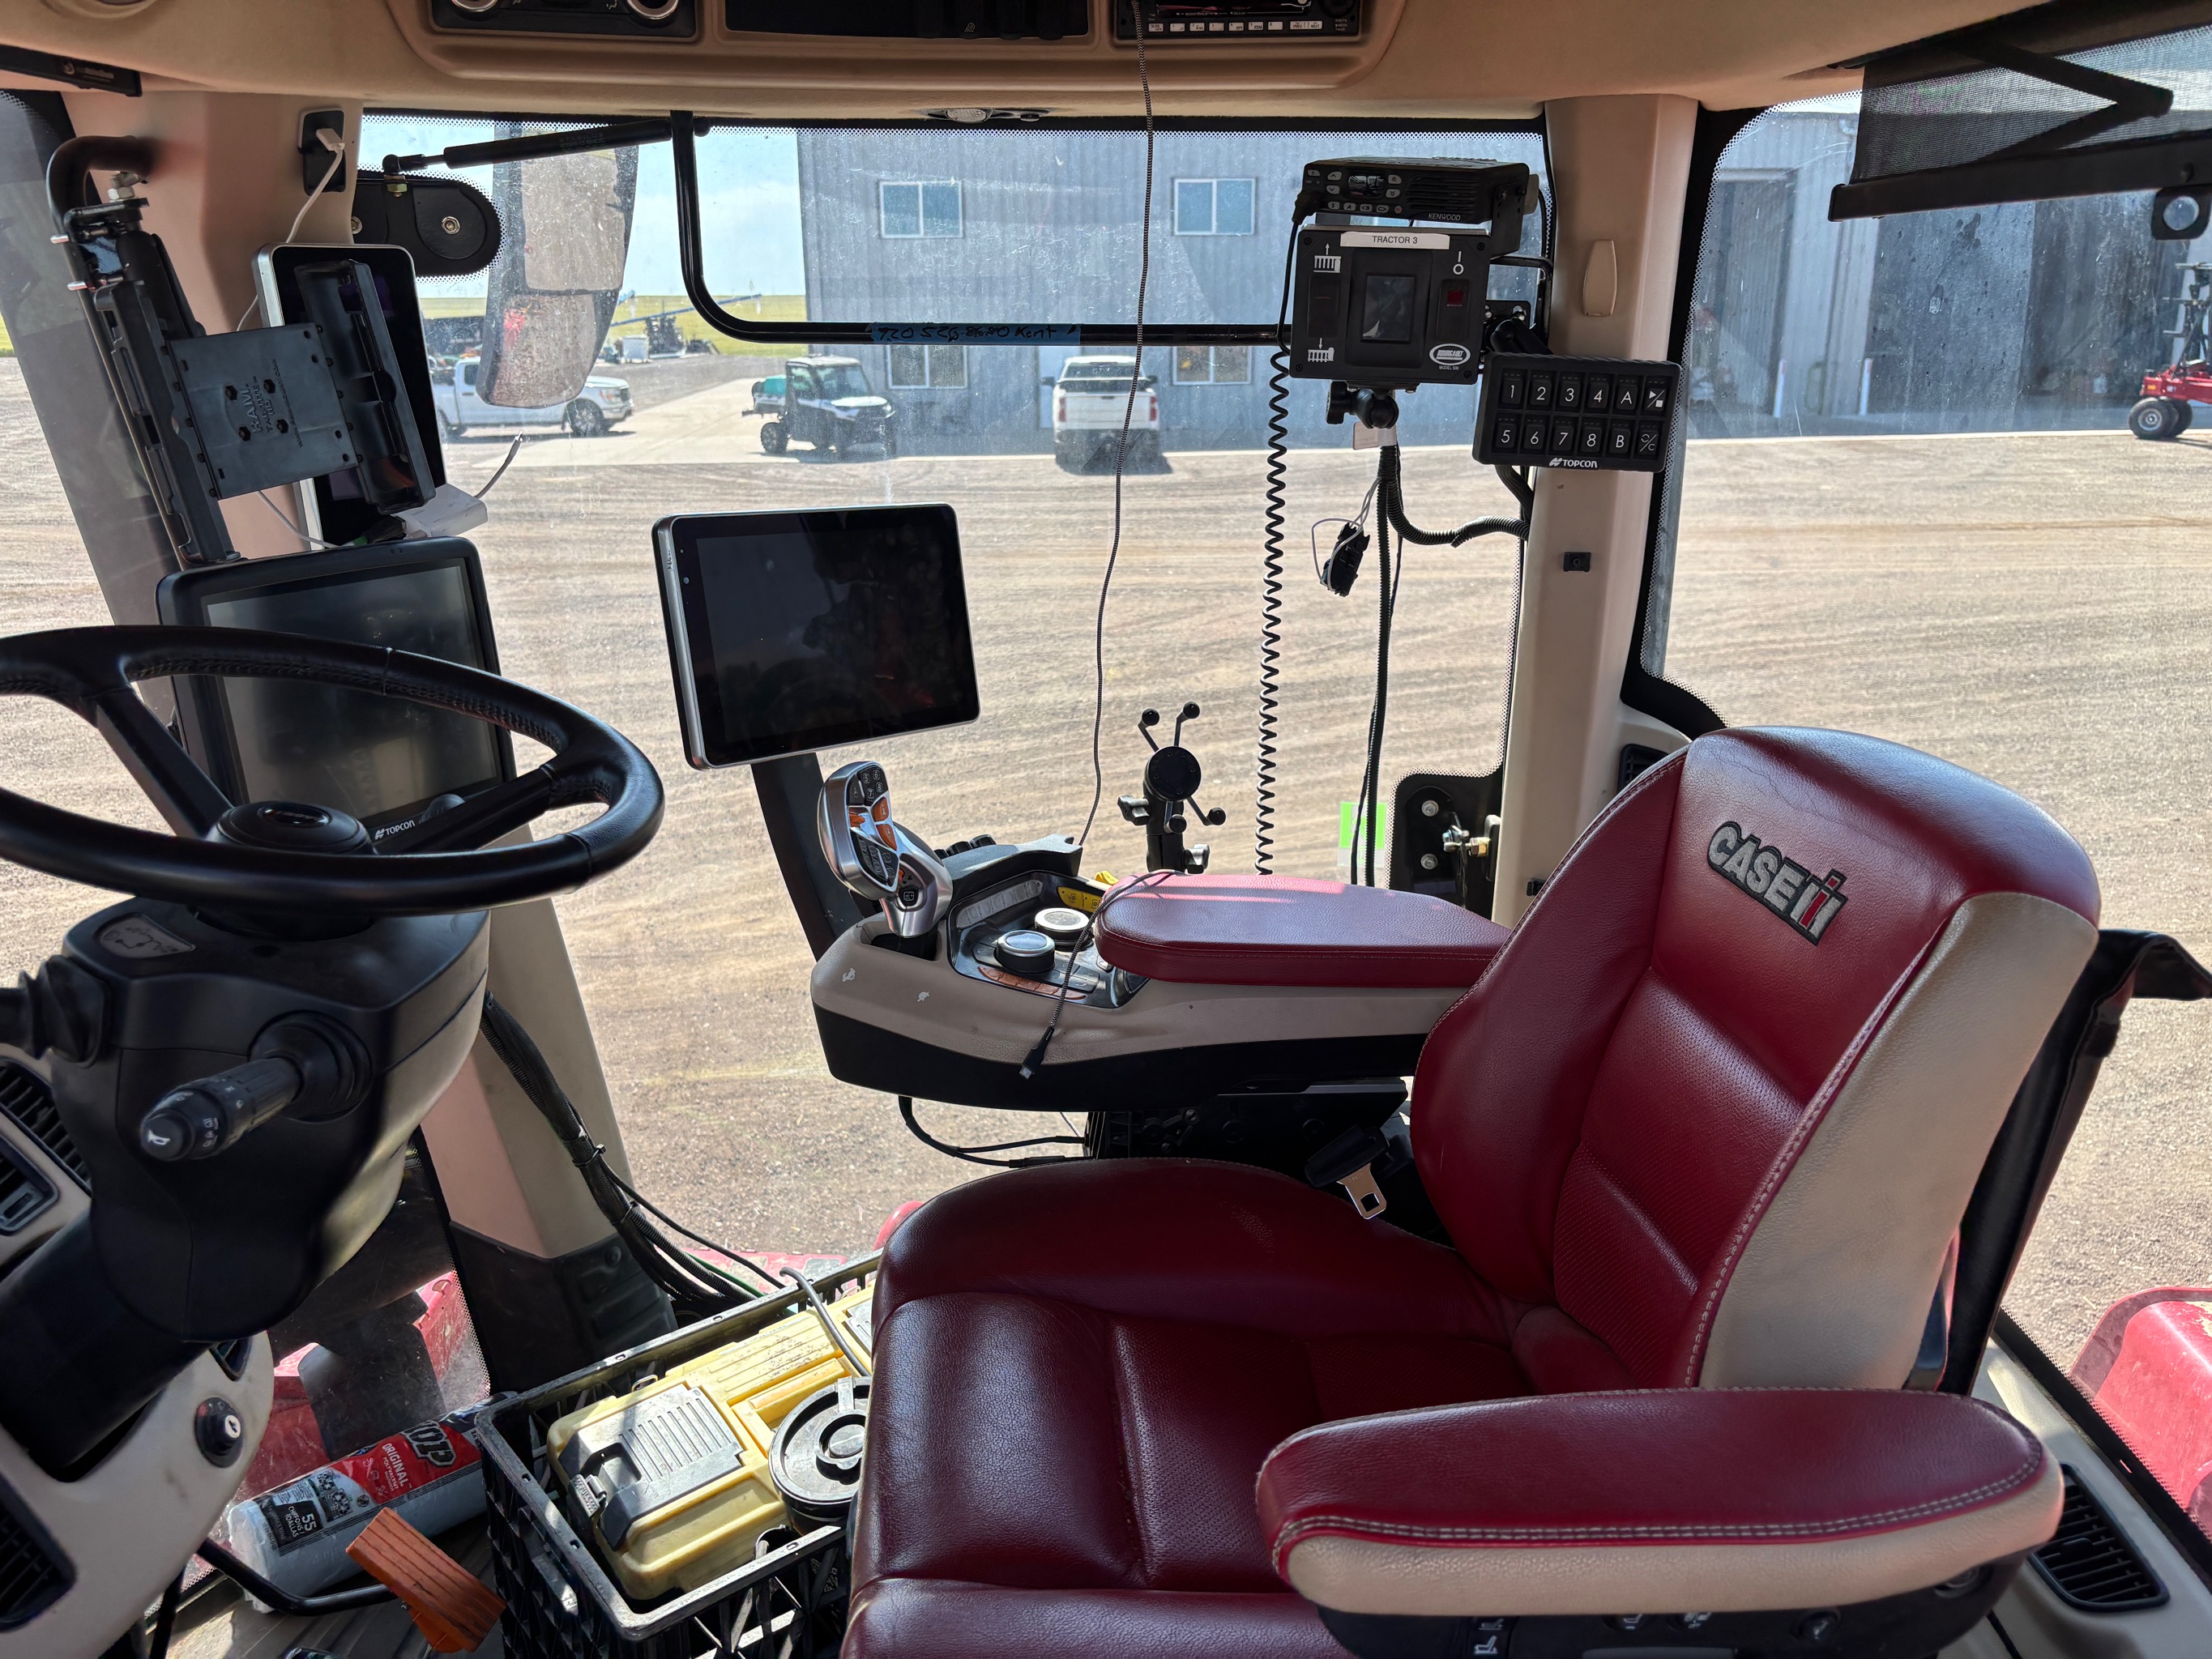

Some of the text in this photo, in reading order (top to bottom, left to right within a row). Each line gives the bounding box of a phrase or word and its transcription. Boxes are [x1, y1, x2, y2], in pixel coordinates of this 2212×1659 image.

[1428, 212, 1461, 221] KENWOOD
[1372, 235, 1418, 245] TRACTOR 3
[1014, 324, 1057, 339] Kent
[1510, 385, 1515, 399] 1
[1535, 386, 1546, 400] 2
[1565, 388, 1575, 402] 3
[1593, 389, 1603, 403] 4
[1620, 390, 1633, 405] A
[240, 389, 263, 433] RAM
[1501, 429, 1511, 444] 5
[1530, 431, 1539, 445] 6
[1558, 432, 1569, 446] 7
[1586, 433, 1596, 447] 8
[1616, 435, 1625, 448] B
[1563, 458, 1598, 469] TOPCON
[385, 820, 416, 836] TOPCON
[382, 1443, 409, 1487] ORIGINAL
[383, 1457, 399, 1490] POLYVALENT
[285, 1514, 299, 1537] TOALLAS
[288, 1506, 304, 1532] CHIFFONS
[301, 1513, 317, 1532] 55
